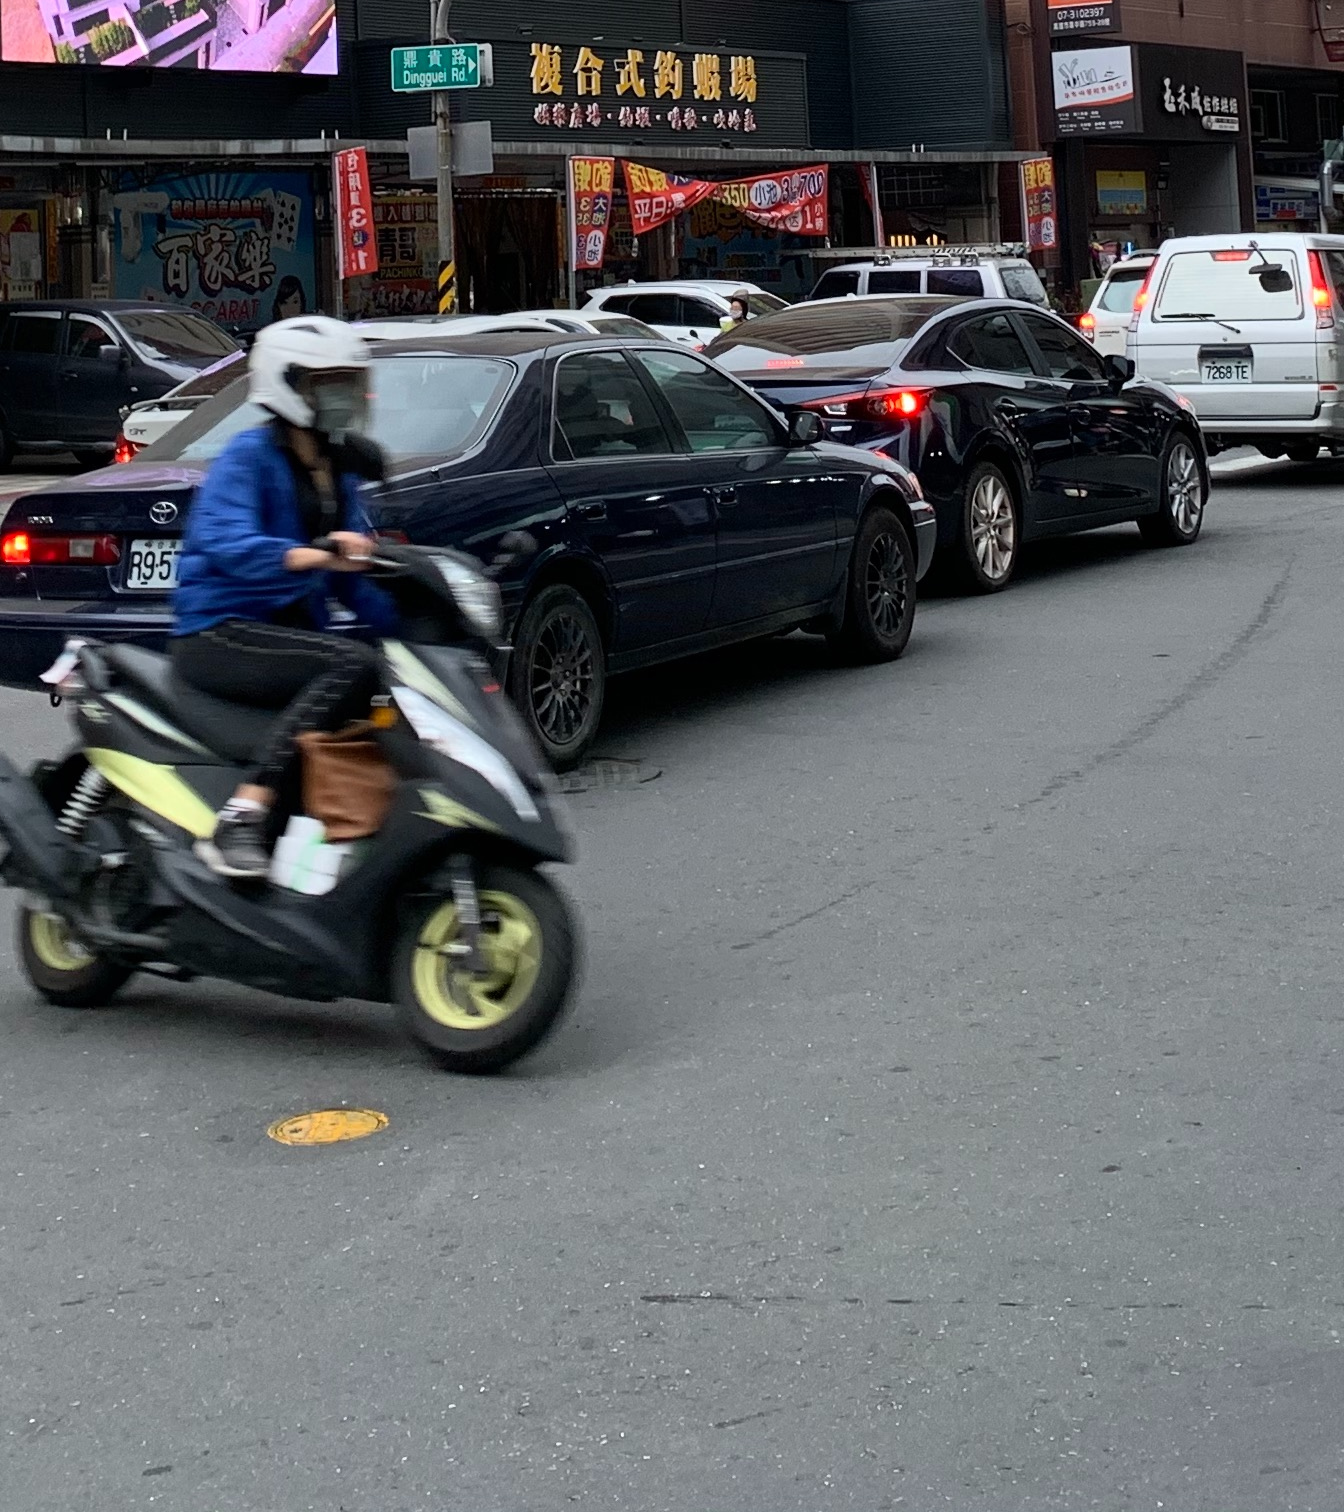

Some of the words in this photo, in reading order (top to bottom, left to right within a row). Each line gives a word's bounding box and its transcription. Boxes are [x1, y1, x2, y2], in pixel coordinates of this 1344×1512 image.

[1056, 7, 1105, 20] 07-3102397
[403, 48, 468, 68] 鼎貴路
[402, 69, 448, 89] Dingguei
[529, 42, 758, 103] 複合式釣蝦場
